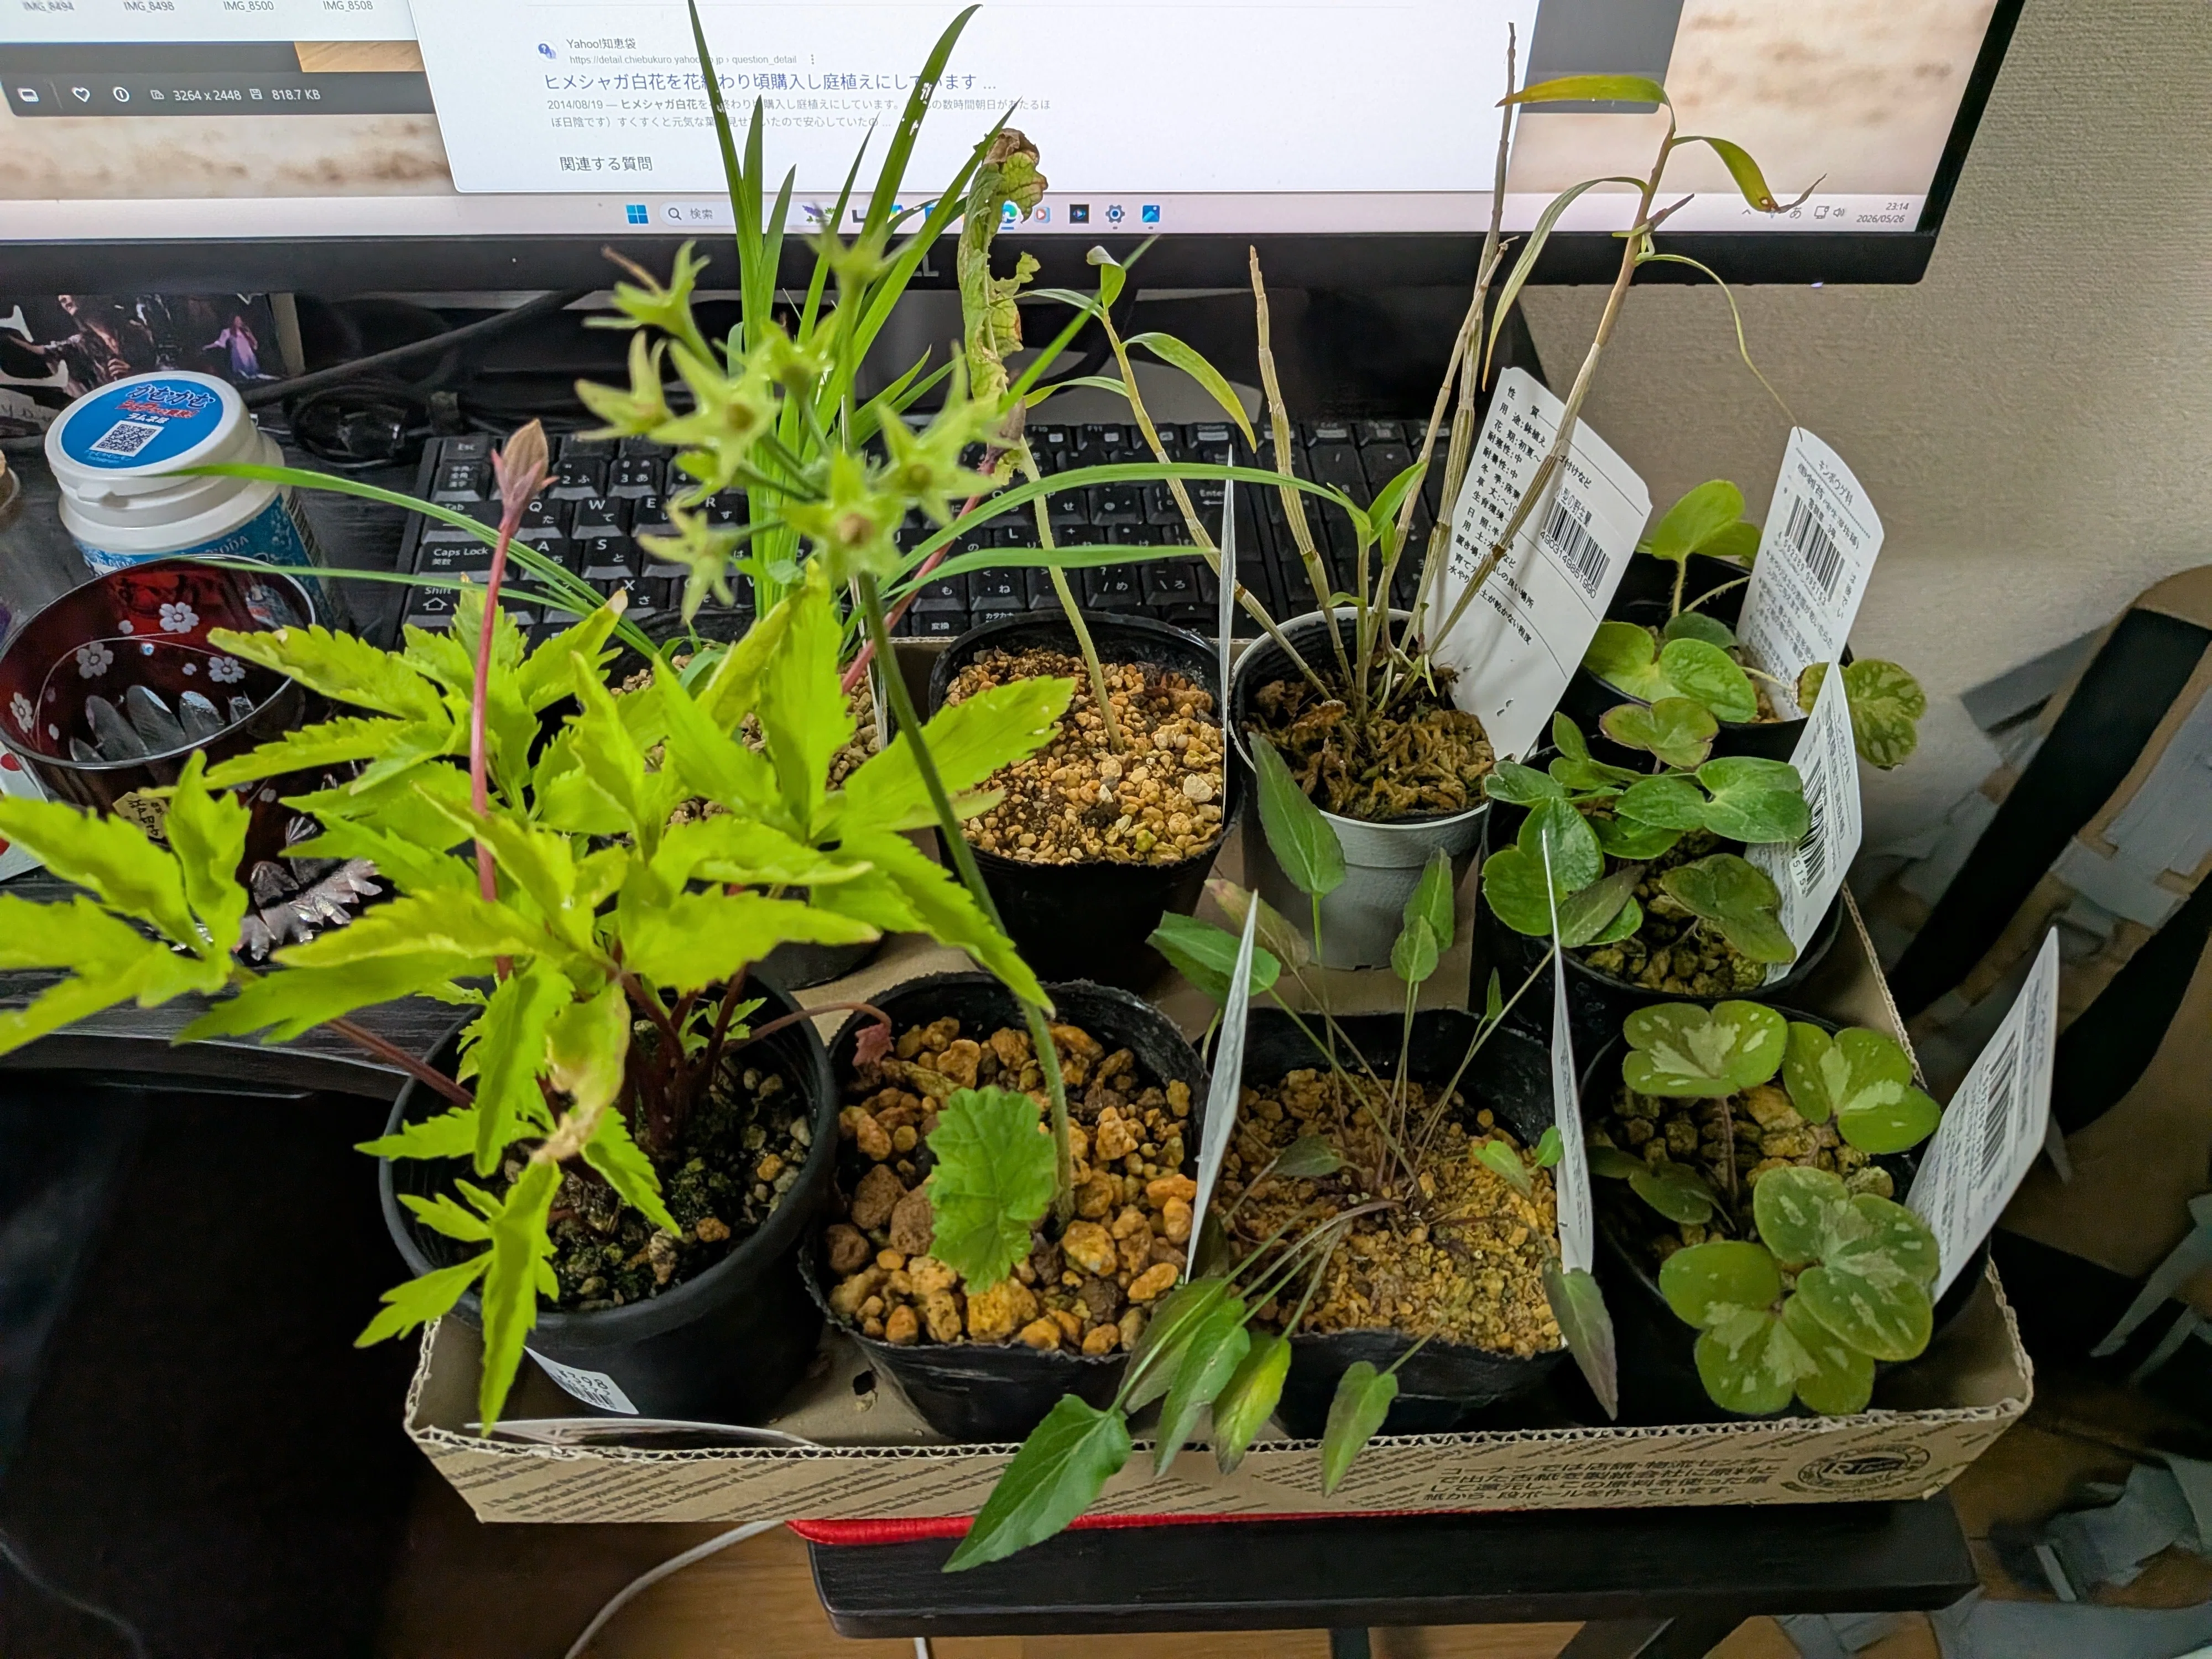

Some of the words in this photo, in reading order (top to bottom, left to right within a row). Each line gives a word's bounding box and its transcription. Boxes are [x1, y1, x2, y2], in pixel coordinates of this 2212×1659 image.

[124, 1, 175, 13] IMG_8498
[224, 1, 274, 12] IMG_8500
[323, 1, 373, 12] IMG_8508
[566, 38, 637, 49] Yahoo!知恵袋
[732, 55, 797, 66] question_detail
[173, 90, 201, 101] 3264
[213, 90, 242, 101] 2448
[272, 90, 301, 100] 818.7
[305, 90, 321, 100] KB
[547, 100, 603, 109] 2014/08/19
[560, 156, 653, 171] 関連する質問
[1886, 202, 1909, 211] 23:14
[690, 208, 713, 220] 検索
[1856, 214, 1905, 223] 2026/05/26
[1507, 386, 1516, 400] 性
[1499, 402, 1509, 415] 用
[1494, 419, 1503, 432] 花
[1480, 463, 1489, 474] 冬
[621, 474, 629, 483] 3
[529, 502, 542, 512] Q
[588, 500, 606, 510] W
[646, 498, 656, 508] E
[705, 497, 716, 508] R
[1063, 502, 1074, 511] せ
[1472, 491, 1505, 522] 生育環境
[603, 513, 614, 522] て
[721, 510, 732, 520] す
[1467, 507, 1475, 518] 日
[542, 515, 554, 524] た
[1462, 520, 1472, 532] 用
[1009, 528, 1019, 539] L
[537, 541, 550, 551] A
[597, 539, 608, 550] S
[434, 549, 460, 557] Caps
[463, 547, 488, 555] Lock
[613, 554, 624, 562] と
[1540, 531, 1597, 599] 4903149851990
[624, 580, 635, 591] X
[999, 585, 1011, 594] ね
[1116, 582, 1128, 591] め
[1174, 580, 1186, 589] ろ
[942, 586, 952, 595] も
[639, 596, 650, 605] さ
[931, 622, 950, 630] 変換
